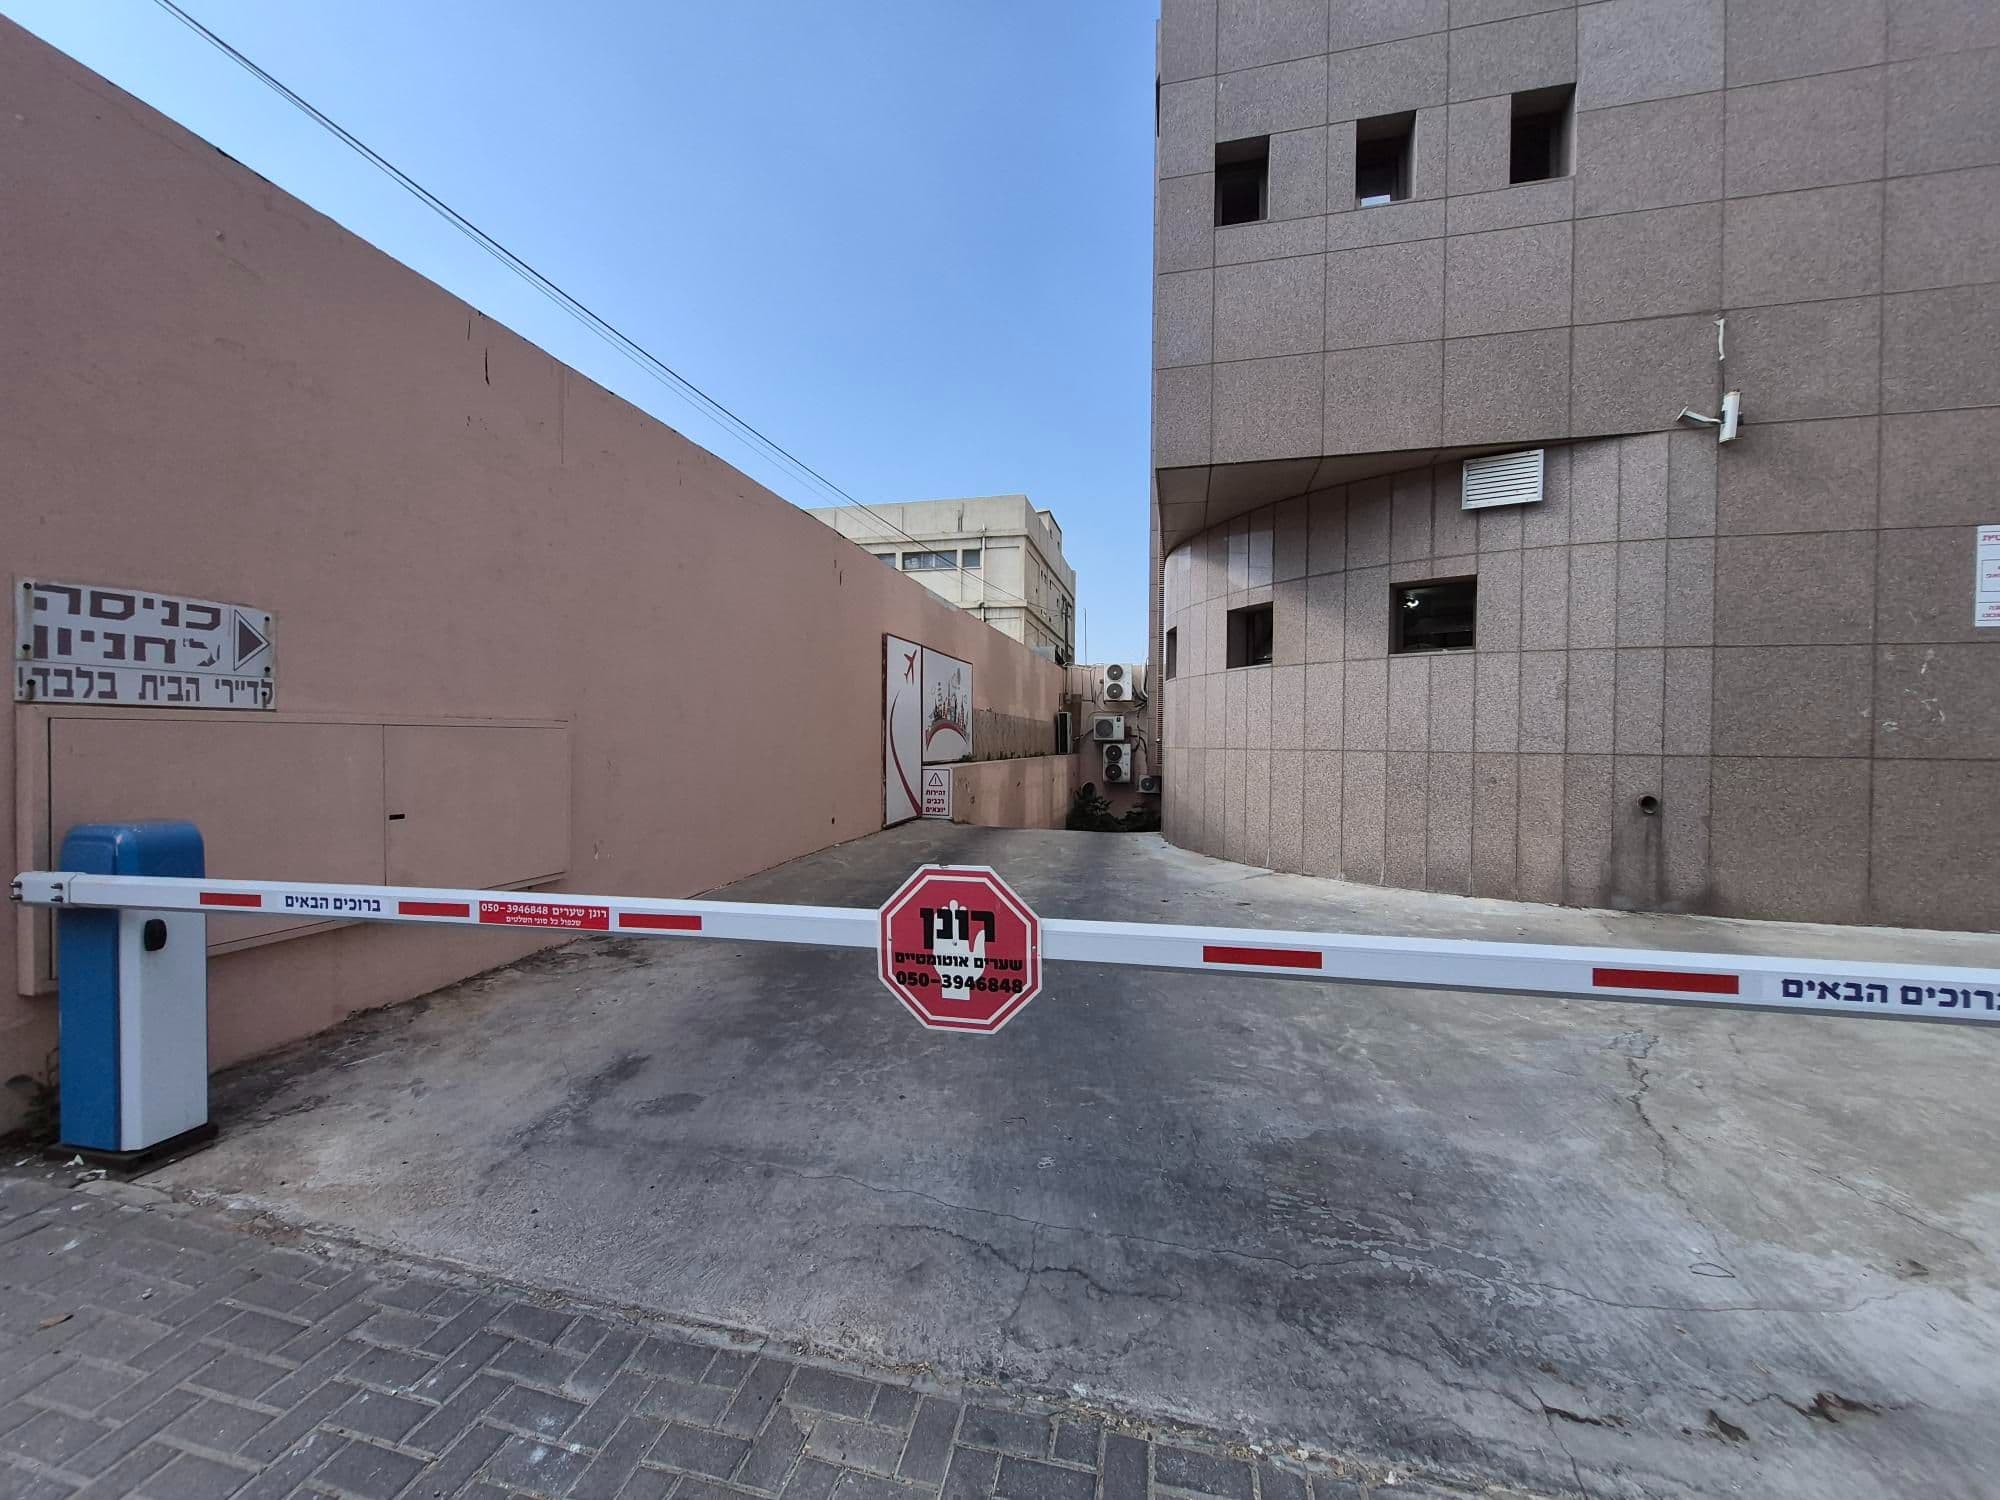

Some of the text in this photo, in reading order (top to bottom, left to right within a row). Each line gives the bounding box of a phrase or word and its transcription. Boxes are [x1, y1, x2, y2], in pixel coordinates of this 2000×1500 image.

[34, 583, 221, 631] כניסה
[138, 674, 200, 702] הבית
[214, 678, 273, 704] לדיירי
[285, 895, 381, 912] ברוכים הבאים
[481, 903, 607, 919] רונן שערים 050-3946848
[550, 916, 559, 925] כל
[919, 907, 996, 950] רונן
[895, 952, 1023, 971] שערים אוטומטיים
[896, 970, 1023, 994] 050-3946848
[1781, 978, 1889, 1004] הבאים
